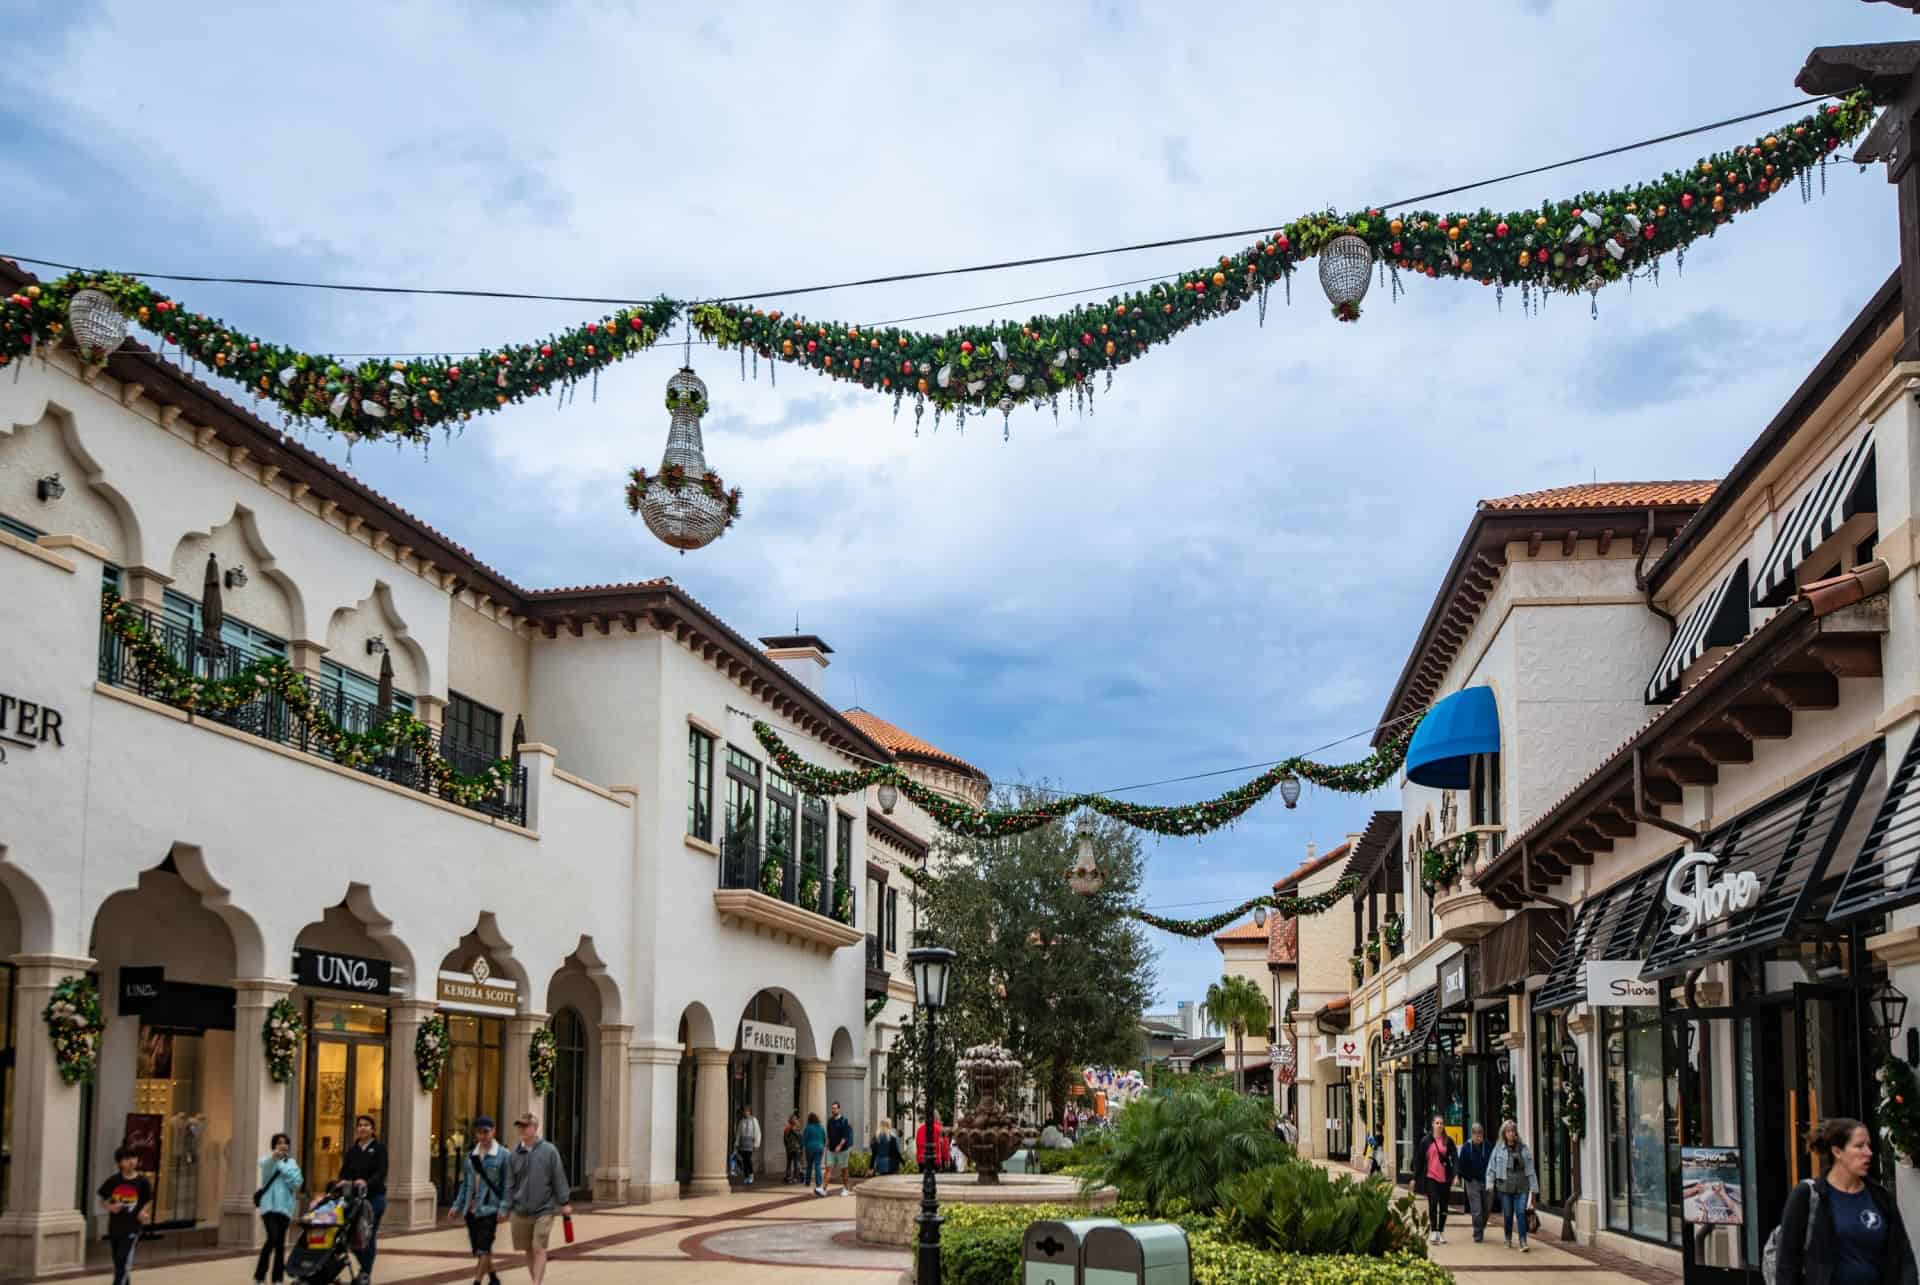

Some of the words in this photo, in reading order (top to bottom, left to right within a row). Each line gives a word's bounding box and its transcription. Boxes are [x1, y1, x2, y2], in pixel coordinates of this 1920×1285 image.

[1666, 852, 1760, 935] Shore
[444, 983, 482, 999] KENDRA
[486, 988, 514, 1003] SCOTT
[1610, 979, 1657, 996] Shore
[754, 1032, 794, 1051] FABLETICS
